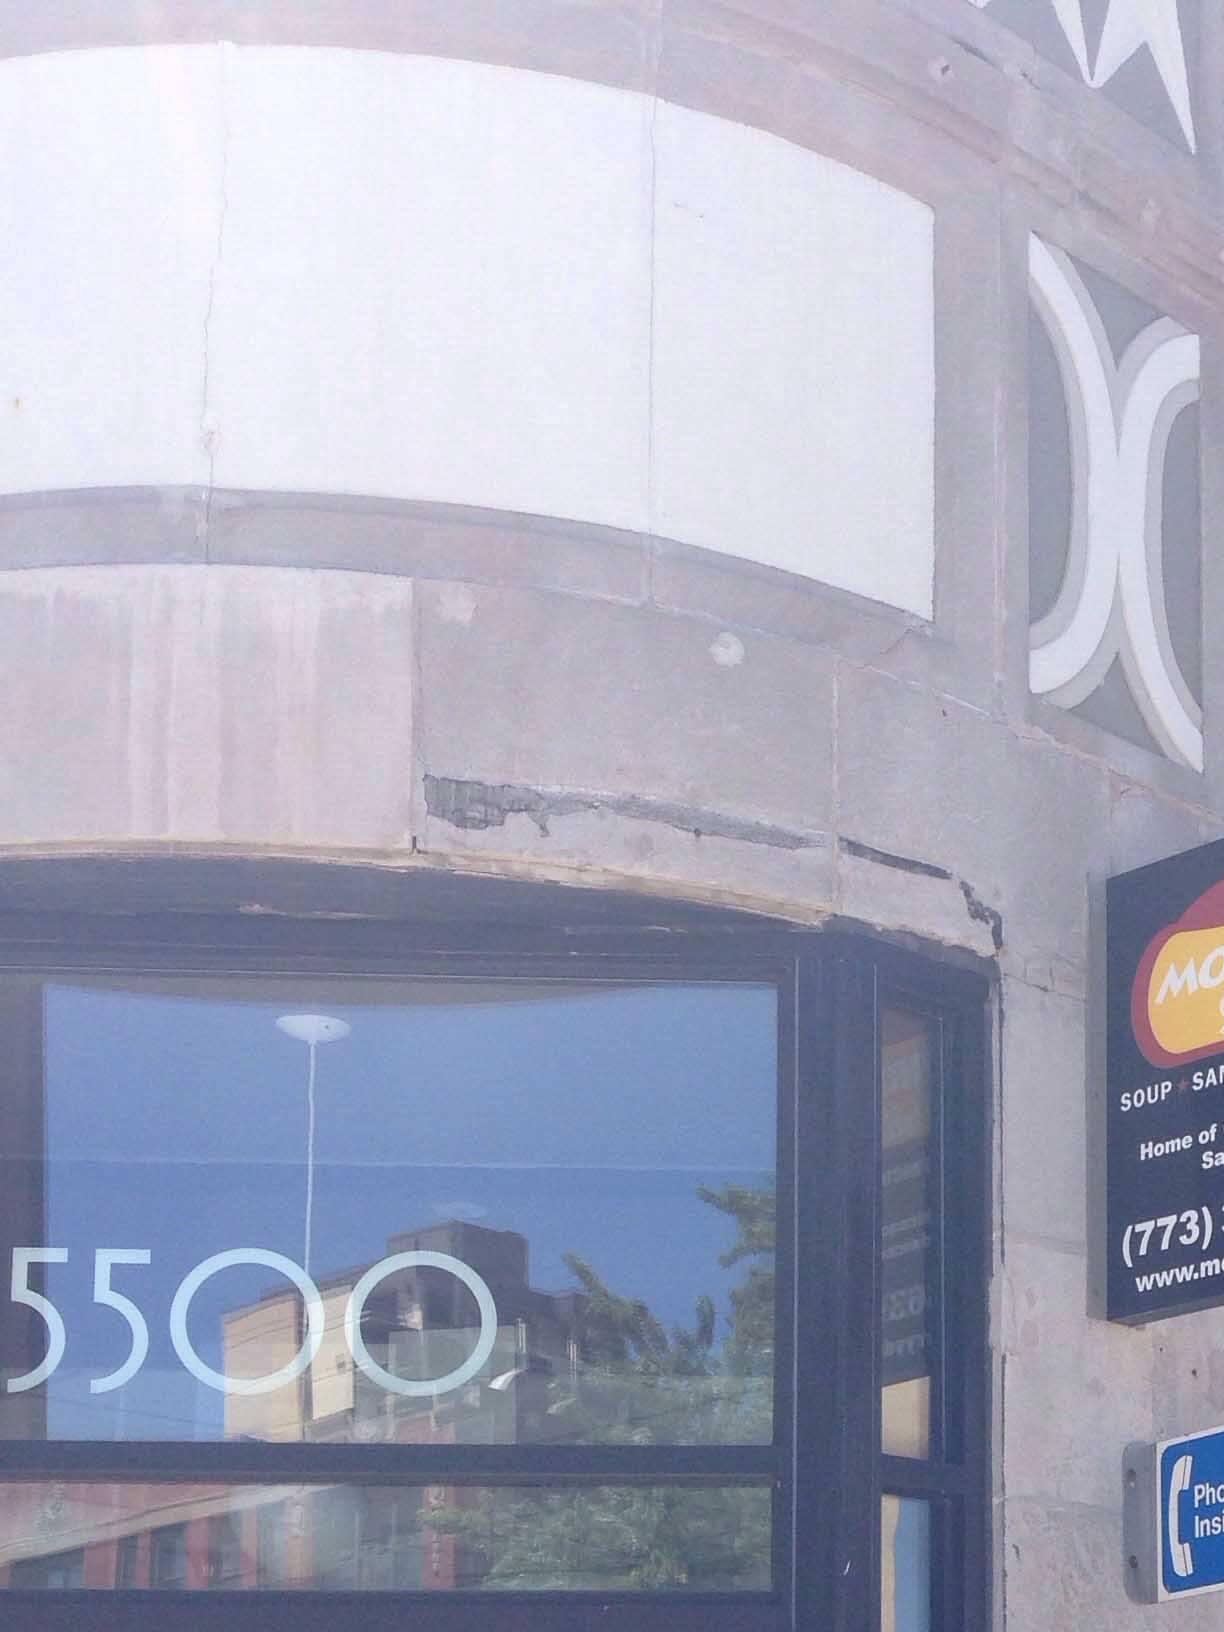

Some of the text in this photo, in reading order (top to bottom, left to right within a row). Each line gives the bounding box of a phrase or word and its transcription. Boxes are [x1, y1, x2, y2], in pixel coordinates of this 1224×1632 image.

[1120, 1081, 1172, 1112] SOUP
[1140, 1134, 1193, 1161] Home
[1198, 1123, 1217, 1145] of
[1122, 1206, 1214, 1268] (773)
[6, 1247, 499, 1395] 5500
